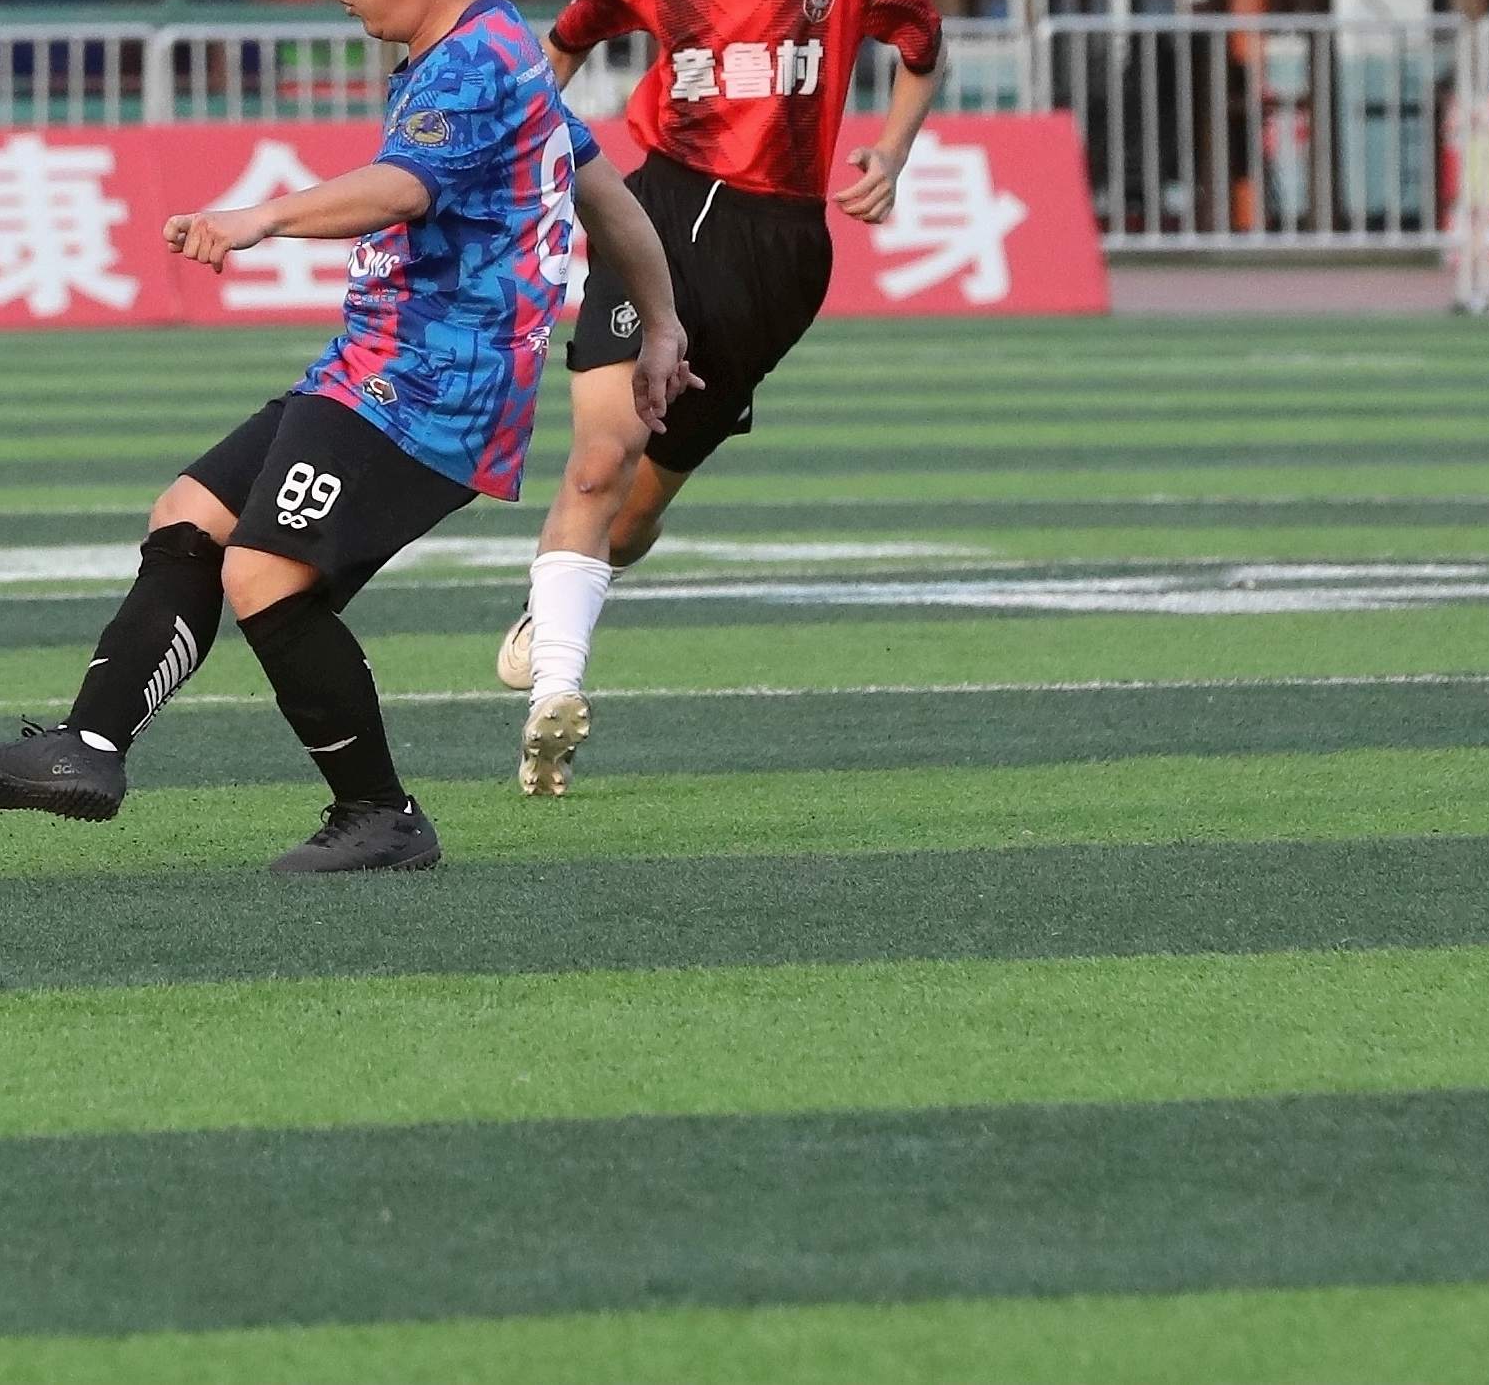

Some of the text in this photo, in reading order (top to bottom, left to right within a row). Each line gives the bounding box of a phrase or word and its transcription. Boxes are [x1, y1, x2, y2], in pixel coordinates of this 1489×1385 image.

[670, 38, 825, 102] 章鲁村
[276, 462, 342, 520] 89
